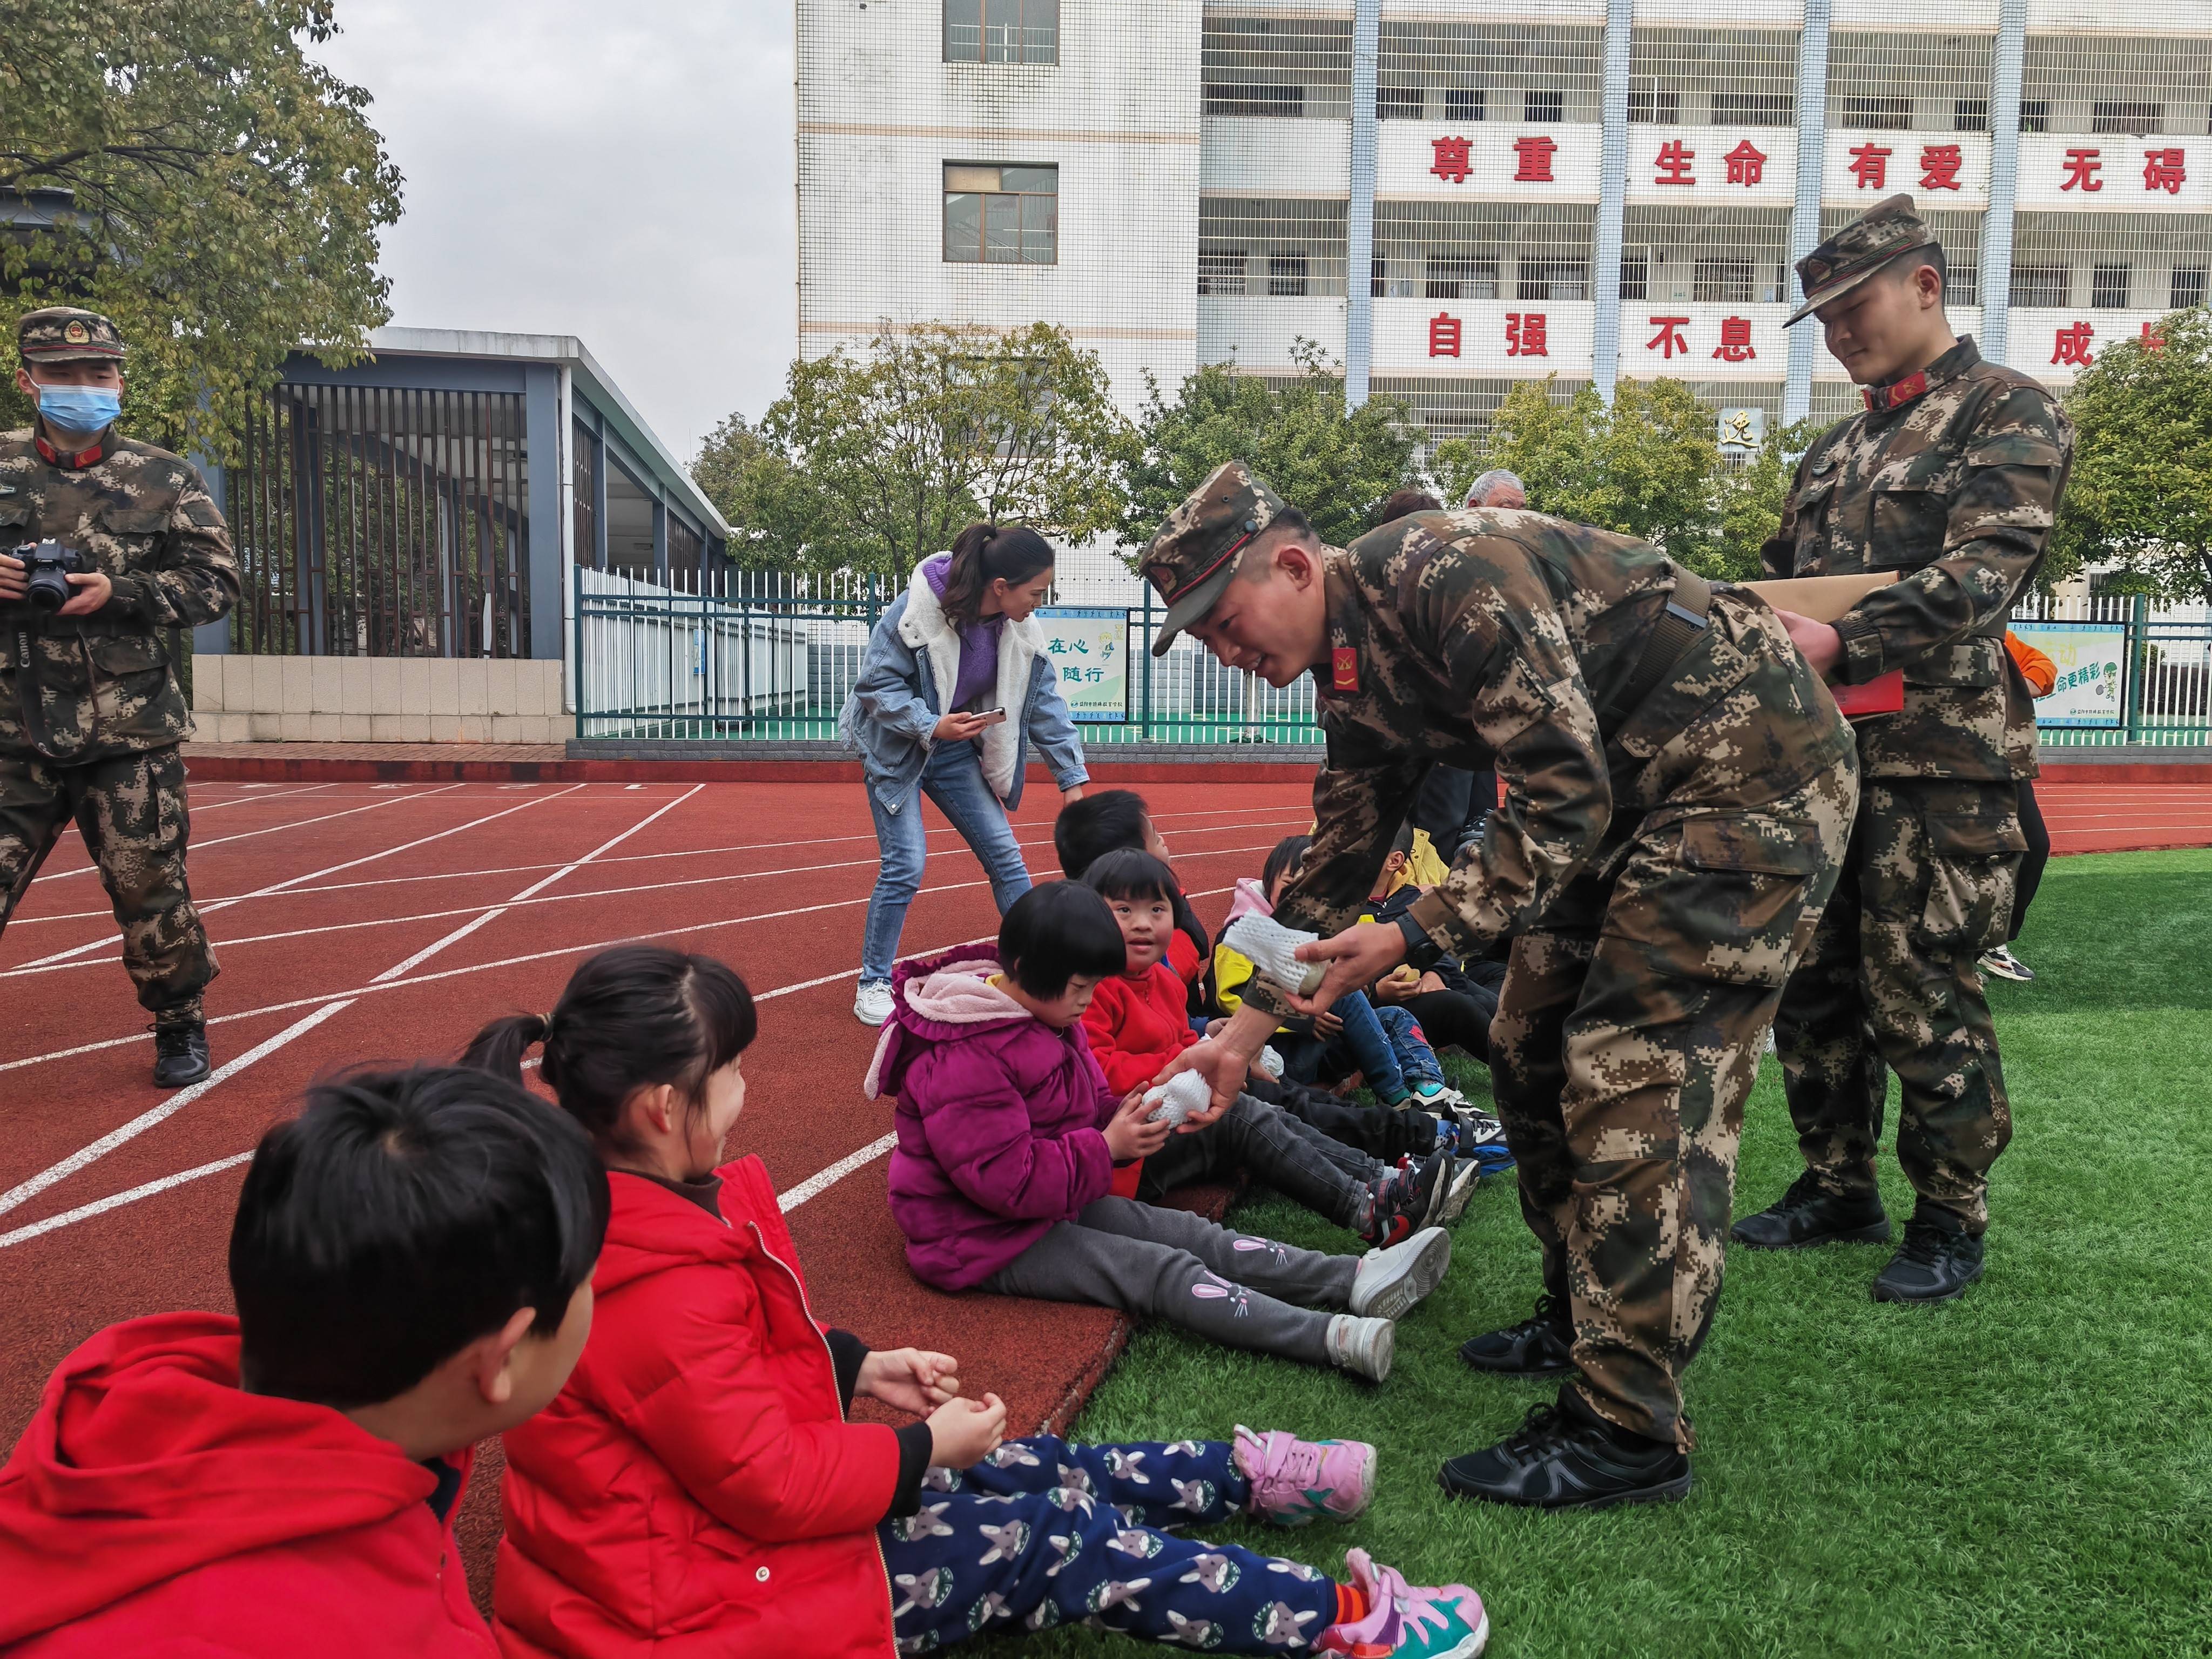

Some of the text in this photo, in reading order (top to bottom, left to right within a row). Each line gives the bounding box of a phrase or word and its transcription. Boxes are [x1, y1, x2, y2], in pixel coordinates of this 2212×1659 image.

[1429, 136, 2187, 194] 尊重 生命 有爱 无碍
[1429, 311, 1548, 358] 自强
[1647, 316, 1756, 361] 不息
[18, 632, 30, 668] Canon
[1048, 638, 1089, 655] 在心
[1062, 666, 1104, 683] 随行
